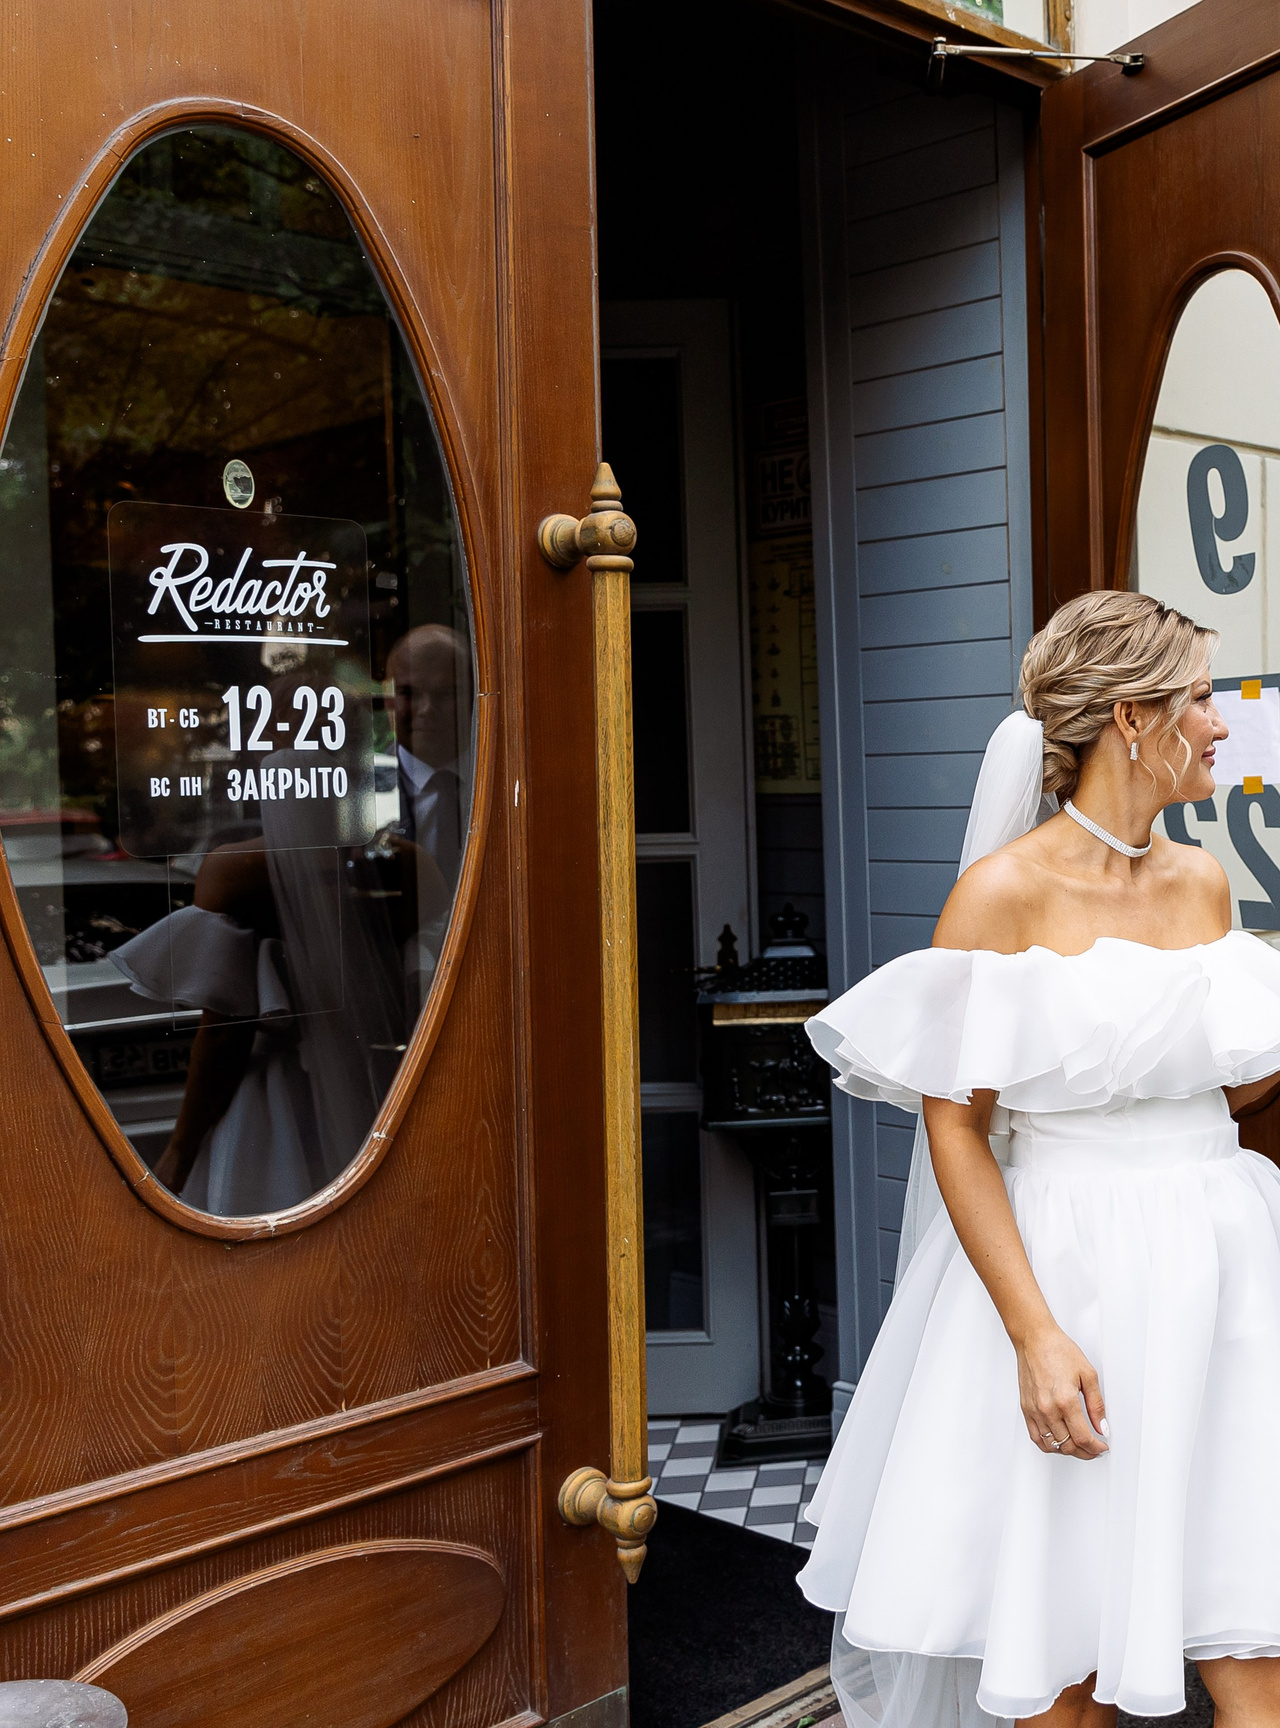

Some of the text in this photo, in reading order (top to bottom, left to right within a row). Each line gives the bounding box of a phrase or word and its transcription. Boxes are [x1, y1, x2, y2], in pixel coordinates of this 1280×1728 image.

[761, 457, 794, 493] НЕ
[762, 496, 810, 523] КУРИТ
[147, 542, 337, 632] Redactor
[214, 618, 314, 633] RESTAURANT
[221, 685, 346, 752] 12-23
[150, 766, 348, 802] ВС ПН ЗАКРЫТО
